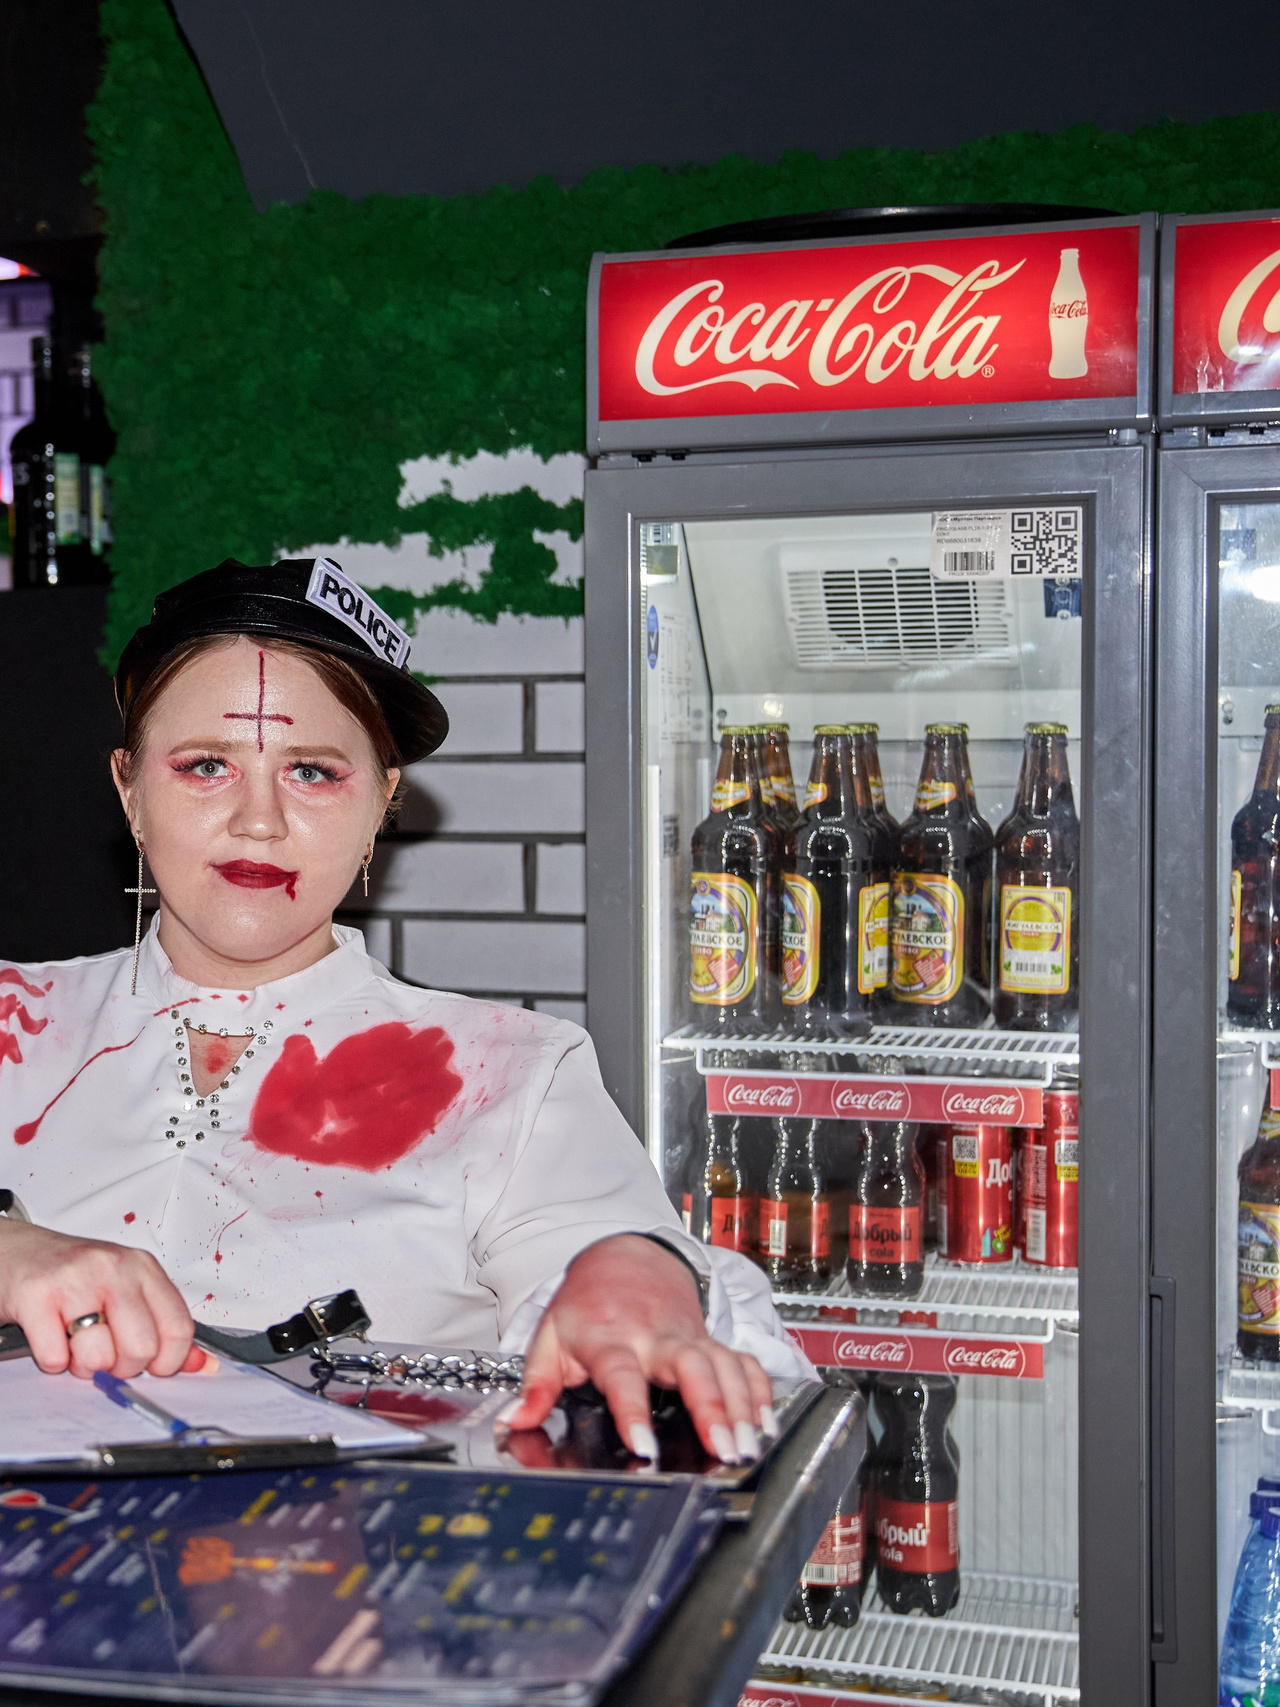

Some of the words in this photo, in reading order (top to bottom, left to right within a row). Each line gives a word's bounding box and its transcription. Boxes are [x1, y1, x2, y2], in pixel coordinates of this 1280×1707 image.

[635, 258, 1027, 396] Coca-Cola
[320, 573, 401, 663] POLICE
[728, 1083, 797, 1107] Coca-Cola
[835, 1087, 908, 1111] Coca-Cola
[946, 1092, 1020, 1116] Coca-Cola
[838, 1340, 908, 1363] Coca-Cola
[947, 1346, 1020, 1370] Coca-Cola
